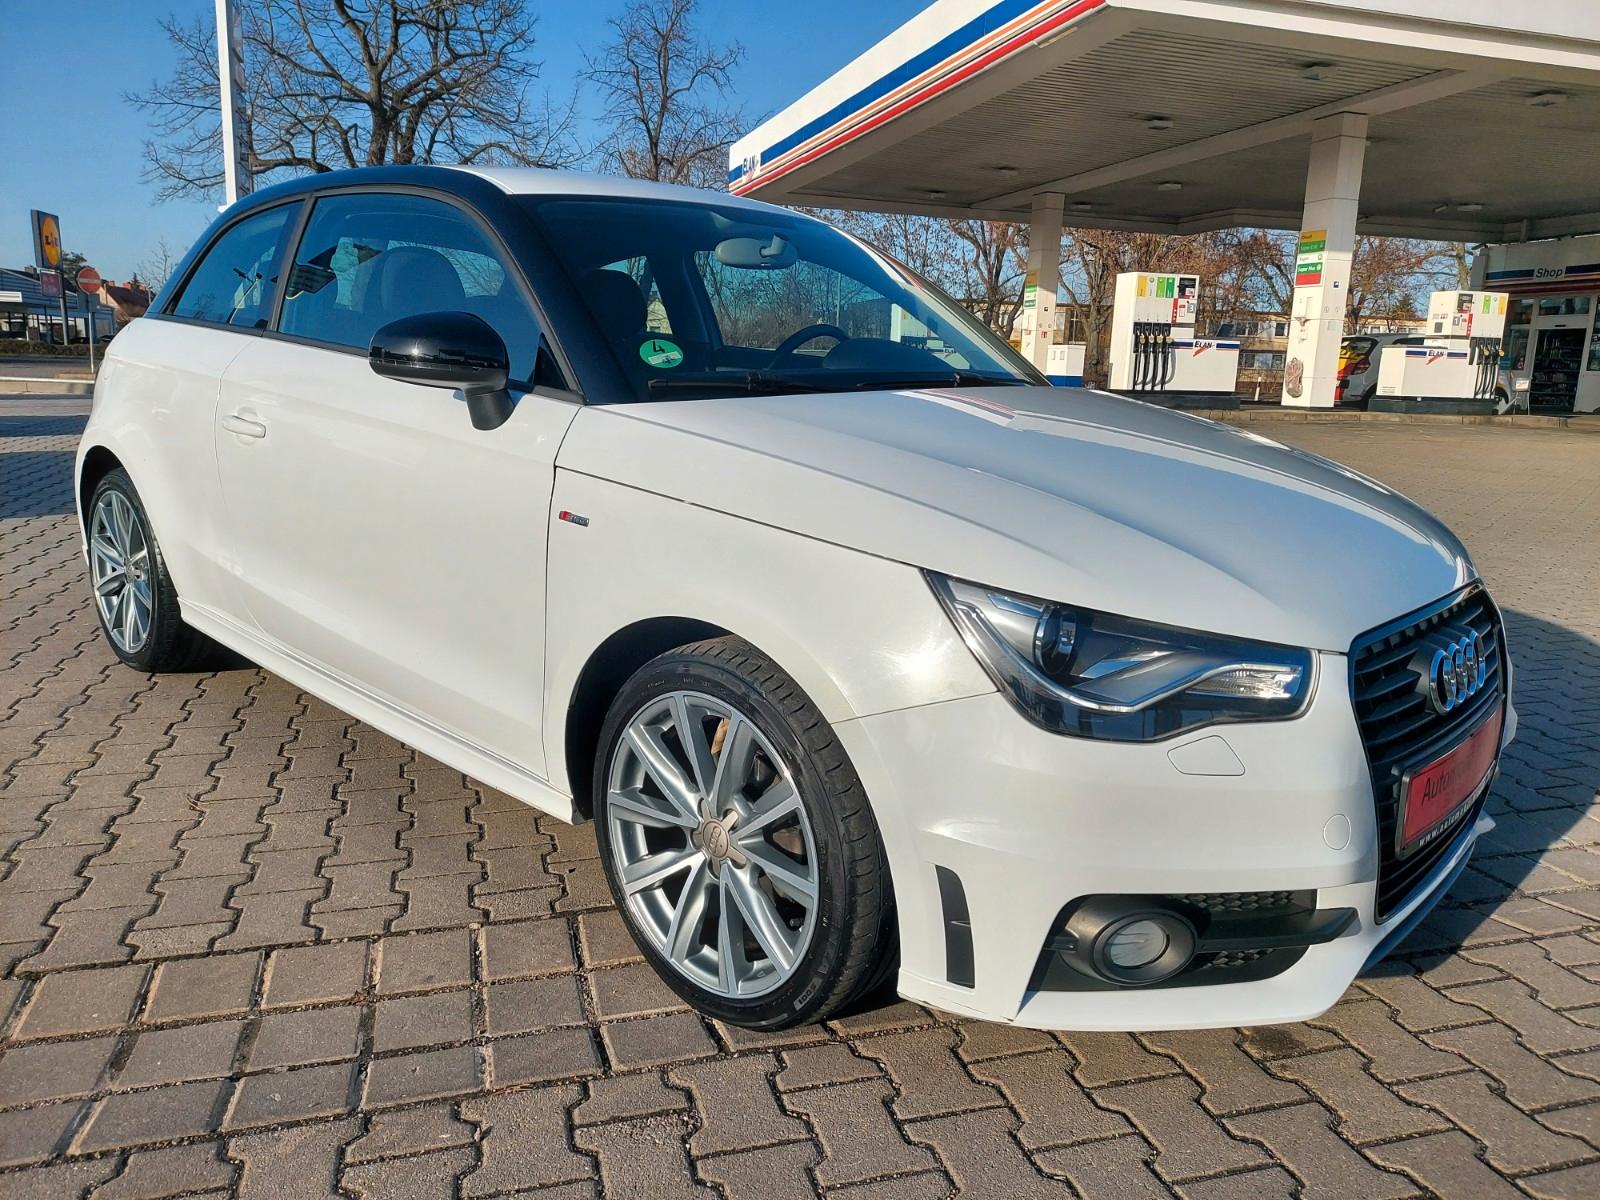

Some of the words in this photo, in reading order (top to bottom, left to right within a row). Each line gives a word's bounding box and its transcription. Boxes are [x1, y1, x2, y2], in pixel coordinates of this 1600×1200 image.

[743, 154, 756, 176] ELAN
[1535, 267, 1563, 278] Shop
[652, 340, 665, 353] 4
